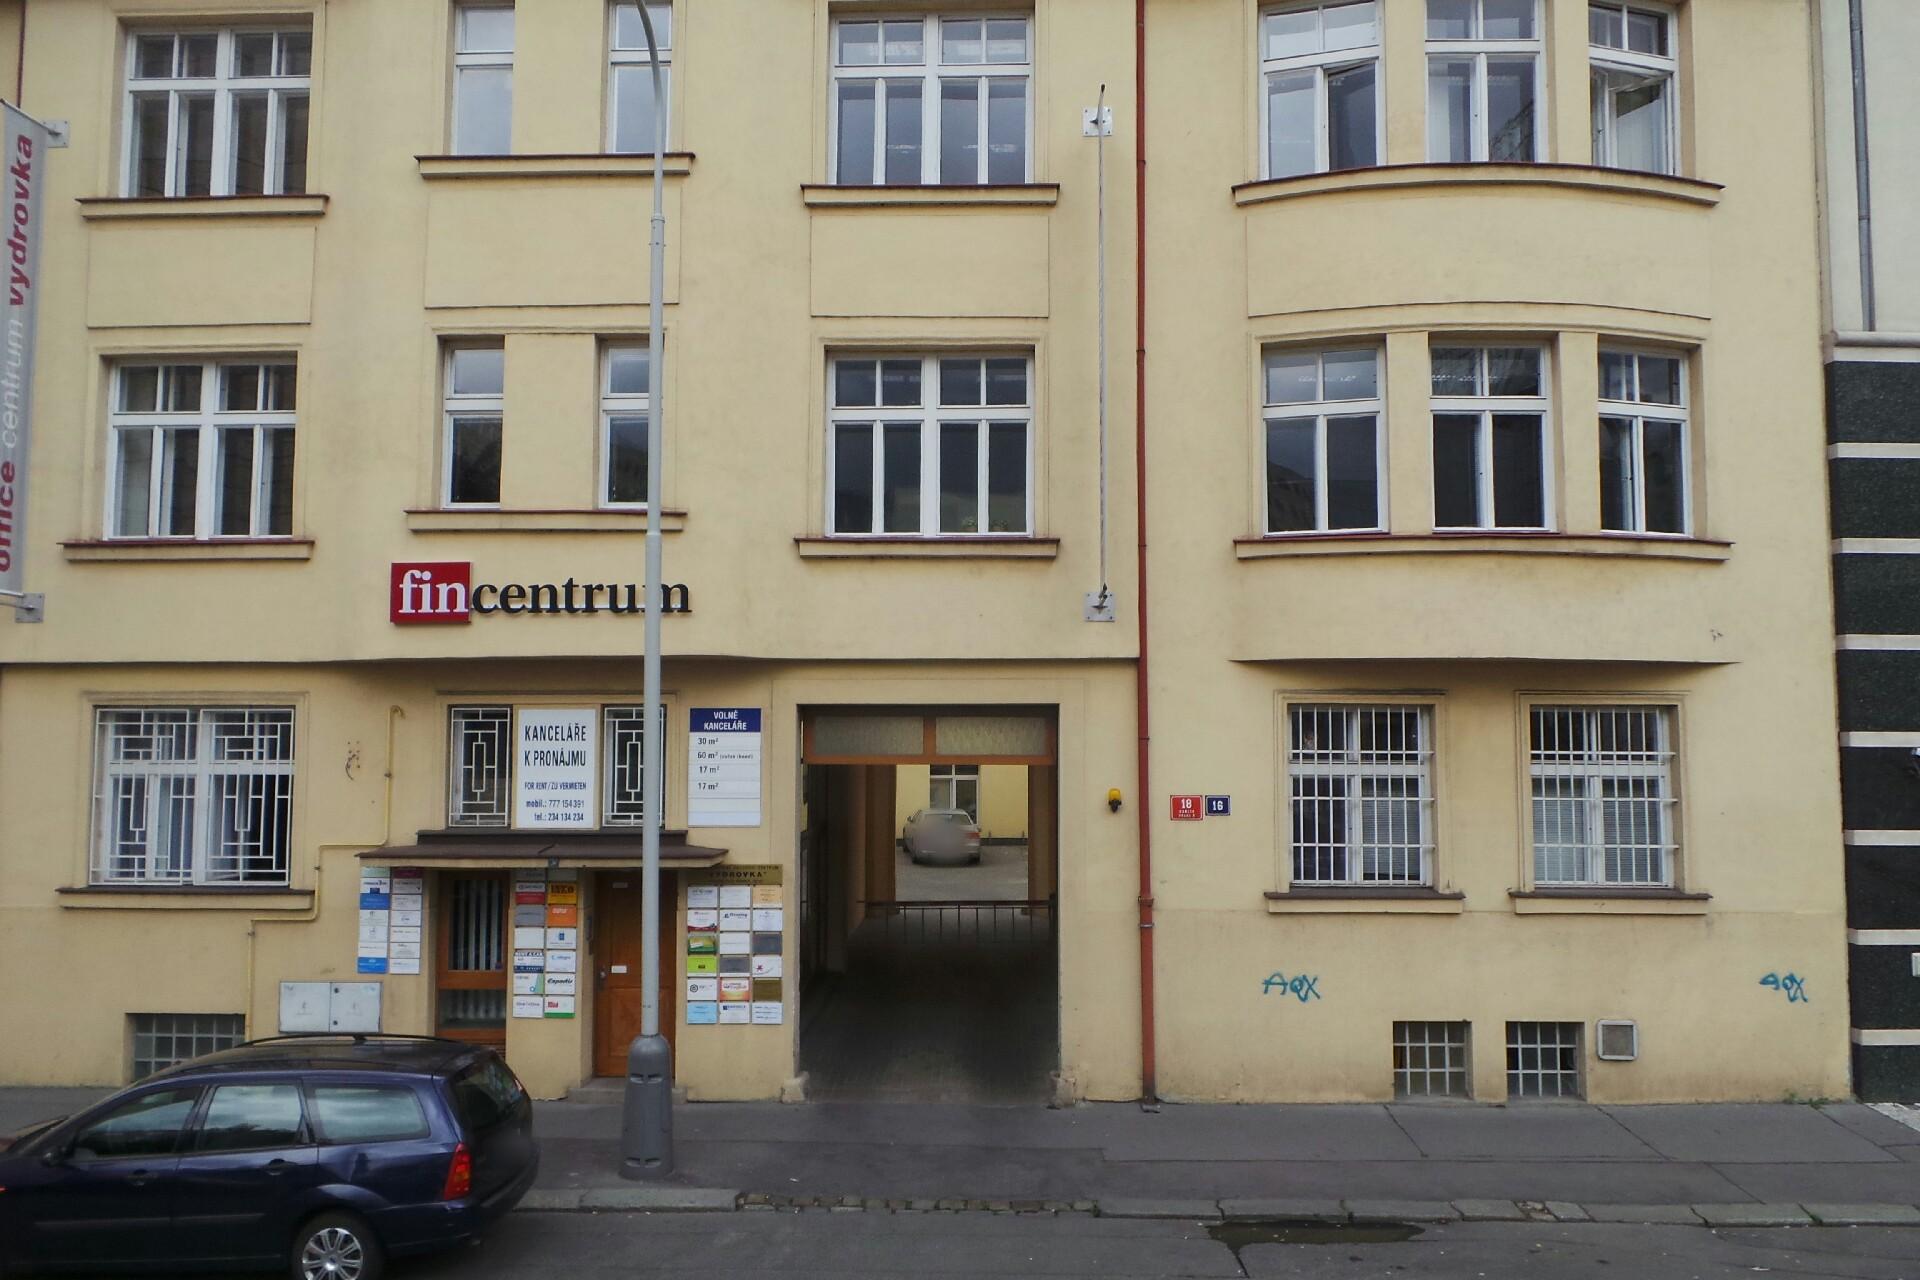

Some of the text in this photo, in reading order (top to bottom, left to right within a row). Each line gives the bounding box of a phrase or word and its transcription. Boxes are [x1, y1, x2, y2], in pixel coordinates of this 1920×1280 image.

[7, 134, 33, 306] vydrovka
[1, 319, 24, 449] centrum
[713, 709, 739, 720] VOLNÉ
[703, 720, 747, 731] KANCELÁŘE
[524, 722, 587, 742] KANCELÁŘE
[697, 737, 707, 745] 30
[524, 747, 587, 767] K PRONÁJMU
[697, 751, 707, 759] 60
[699, 765, 708, 774] 17
[524, 781, 535, 791] FOR
[697, 782, 707, 791] 17
[548, 799, 561, 808] 777
[1181, 798, 1192, 809] 18
[1212, 801, 1223, 811] 16
[548, 812, 559, 821] 234
[561, 812, 571, 821] 134
[573, 812, 584, 821] 234
